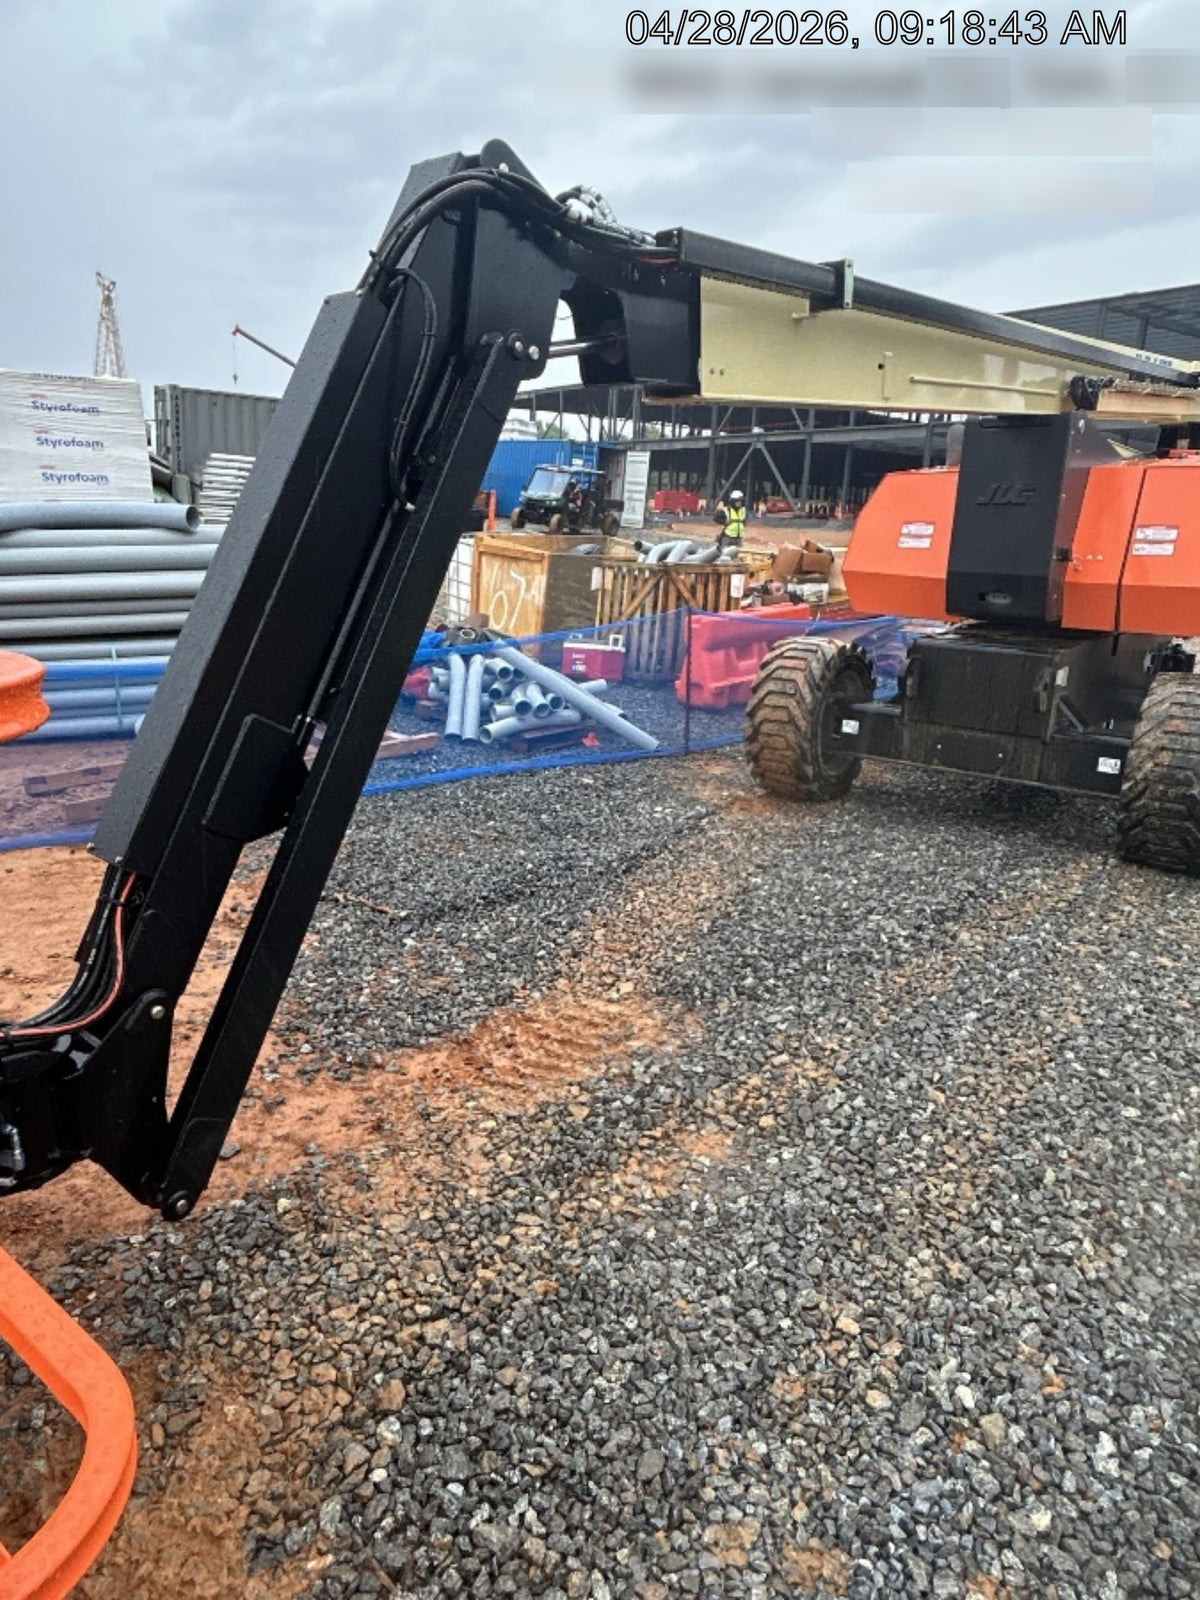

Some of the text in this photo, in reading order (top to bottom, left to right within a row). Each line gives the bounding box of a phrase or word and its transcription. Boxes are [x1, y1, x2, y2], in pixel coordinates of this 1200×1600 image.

[30, 400, 101, 413] Styrofoam
[36, 436, 104, 448] Styrofoam
[41, 472, 109, 484] Styrofoam
[975, 482, 1038, 506] JLG
